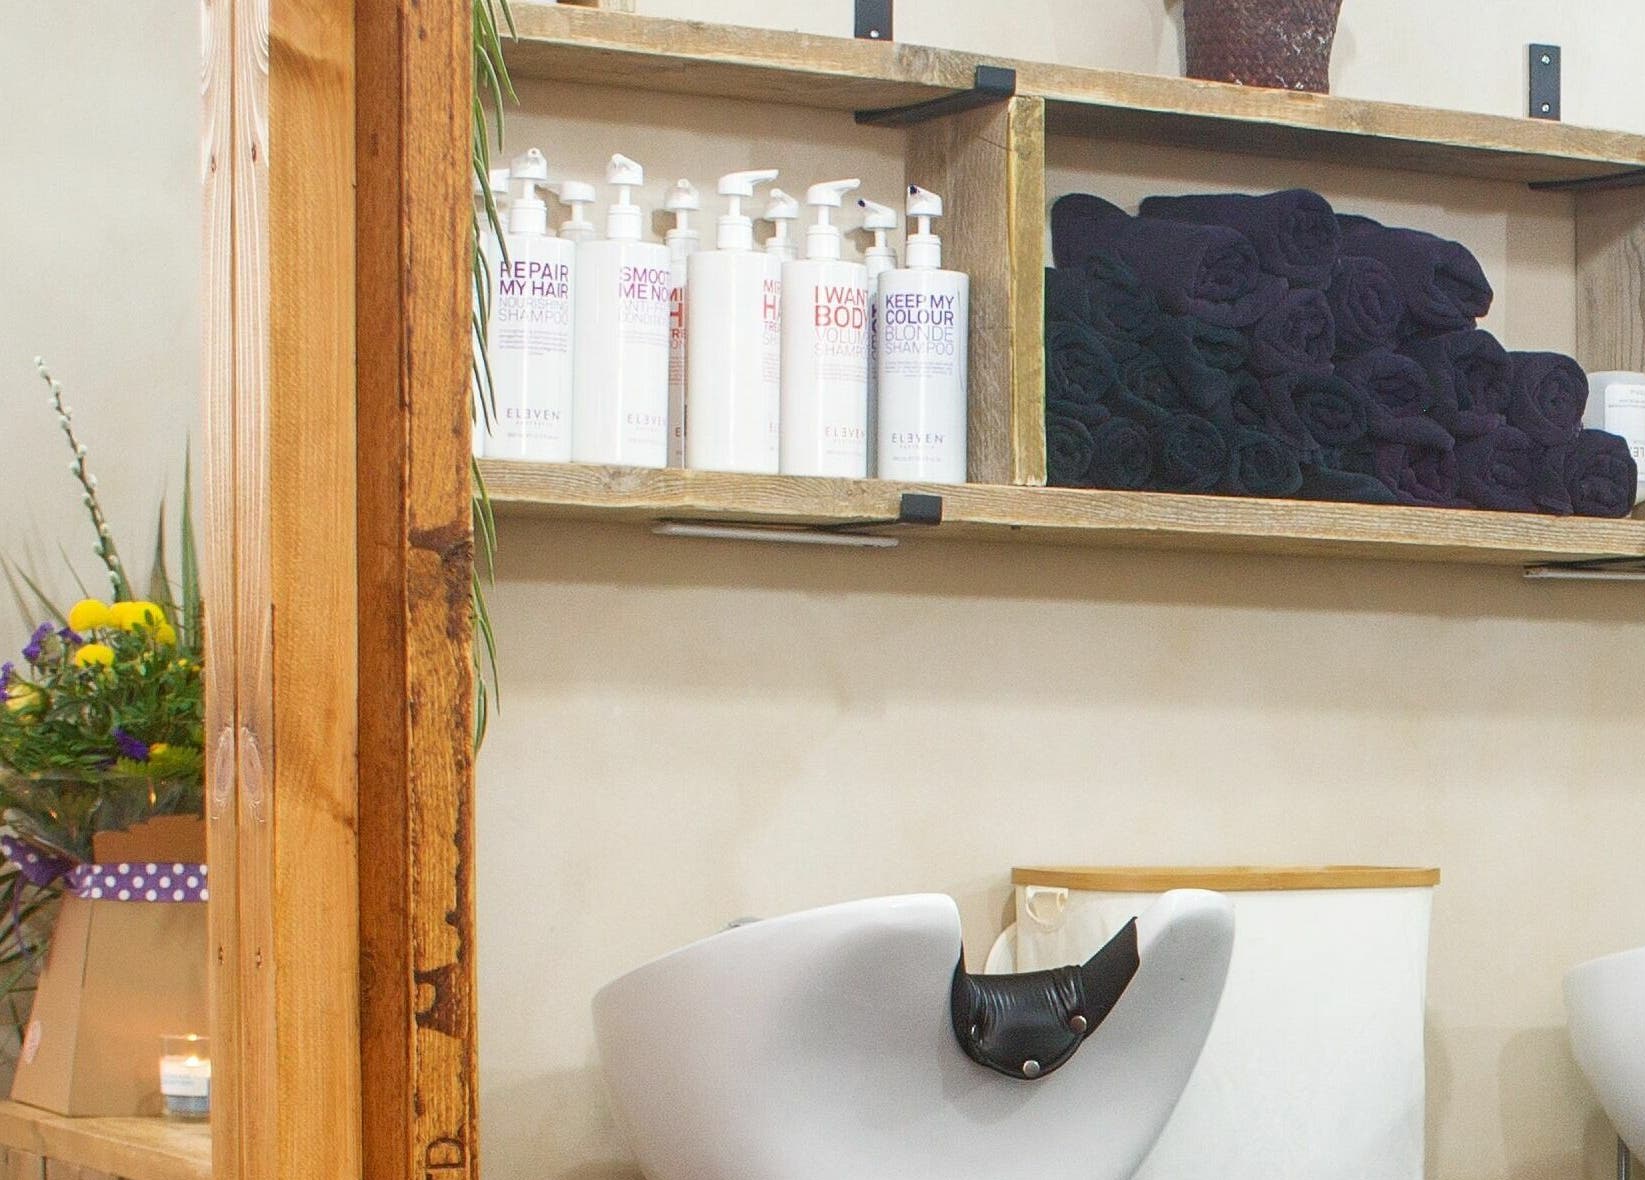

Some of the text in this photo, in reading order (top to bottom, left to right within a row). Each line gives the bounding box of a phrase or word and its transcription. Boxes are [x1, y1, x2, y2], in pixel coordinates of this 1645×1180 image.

[500, 261, 569, 282] REPAIR
[500, 281, 569, 300] MY HAIR
[815, 285, 821, 303] I
[885, 294, 955, 310] KEEP MY
[885, 309, 954, 326] COLOUR
[885, 326, 954, 343] BLONDE
[885, 341, 954, 356] SHAMPOO
